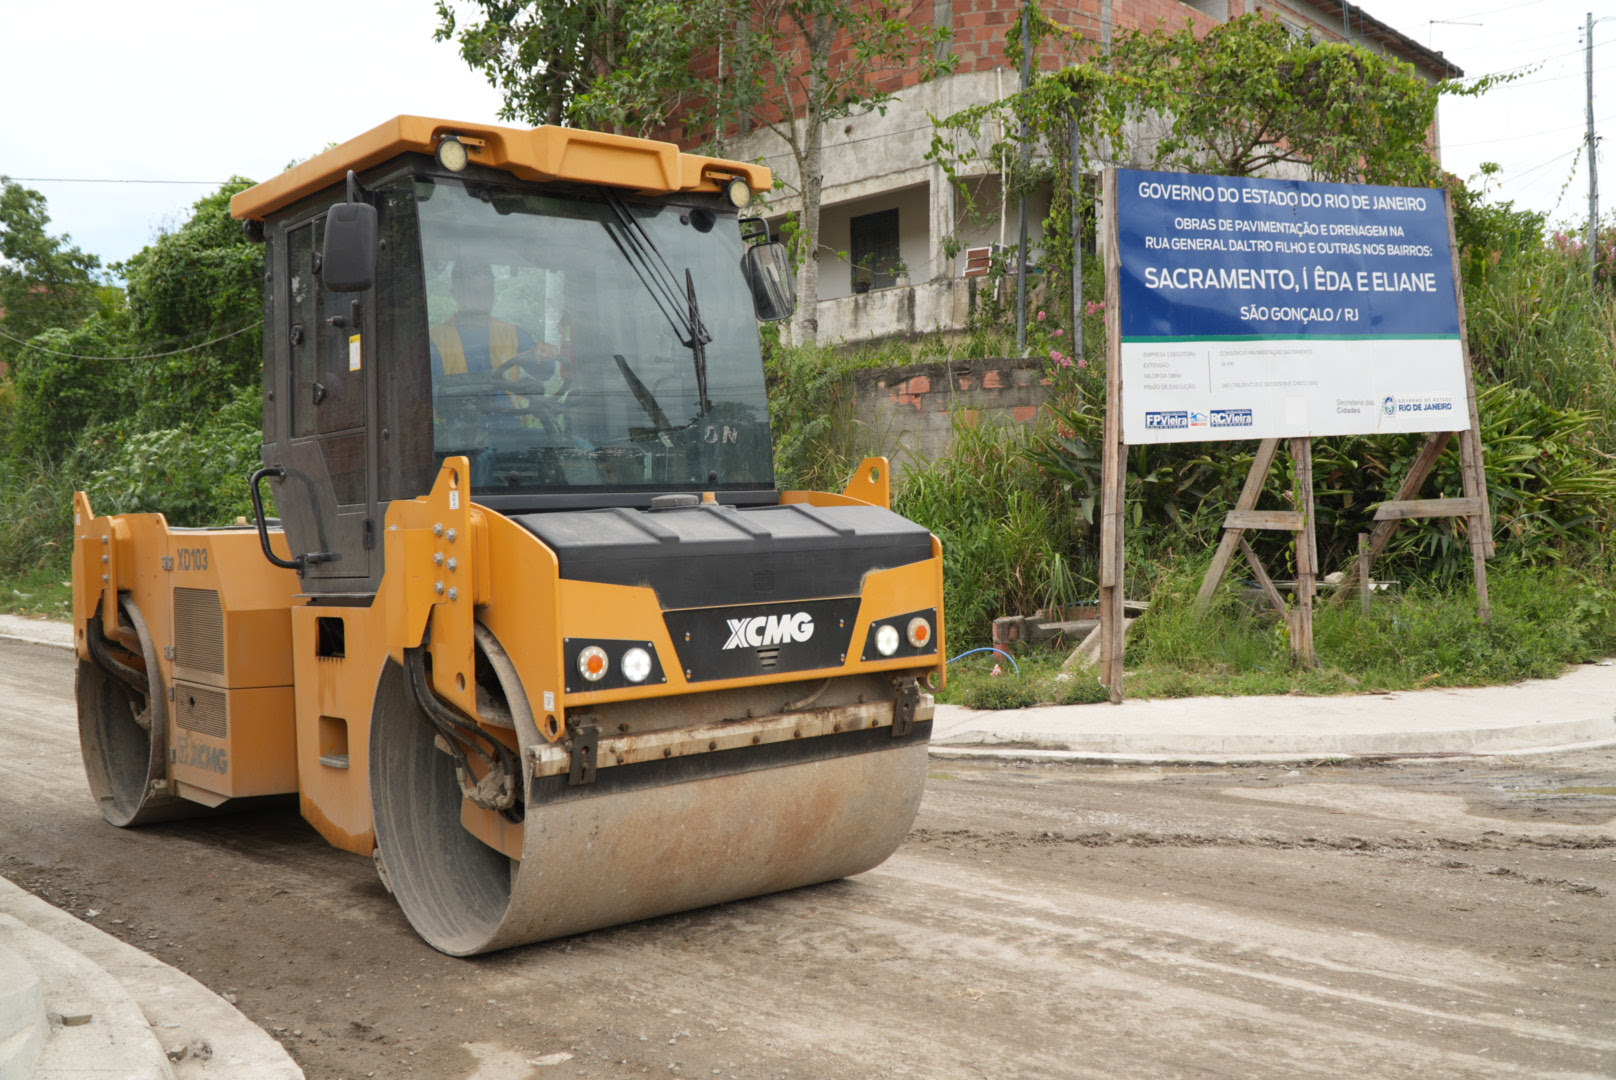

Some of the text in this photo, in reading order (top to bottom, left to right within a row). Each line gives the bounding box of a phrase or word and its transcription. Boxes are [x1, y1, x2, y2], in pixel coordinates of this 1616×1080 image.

[1138, 182, 1427, 212] GOVERNO DO ESTADO DO RIO DE JANEIRO
[1174, 217, 1405, 237] OBRAS DE PAVIMENTAÇÃO E DRENAGEM NA
[1145, 236, 1433, 257] RUA GENERAL DALTRO FILHO E OUTRAS NOS BAIRROS:
[1144, 267, 1299, 292] SACRAMENTO,
[1314, 265, 1353, 292] ÊDA
[1356, 271, 1369, 292] E
[1372, 271, 1437, 292] ELIANE
[1240, 304, 1359, 325] SÃO GONÇALO / RJ
[1336, 406, 1361, 414] Cidades
[1398, 402, 1453, 412] RIO DE JANEIRO
[176, 547, 209, 571] XD103
[722, 611, 815, 650] XCMG
